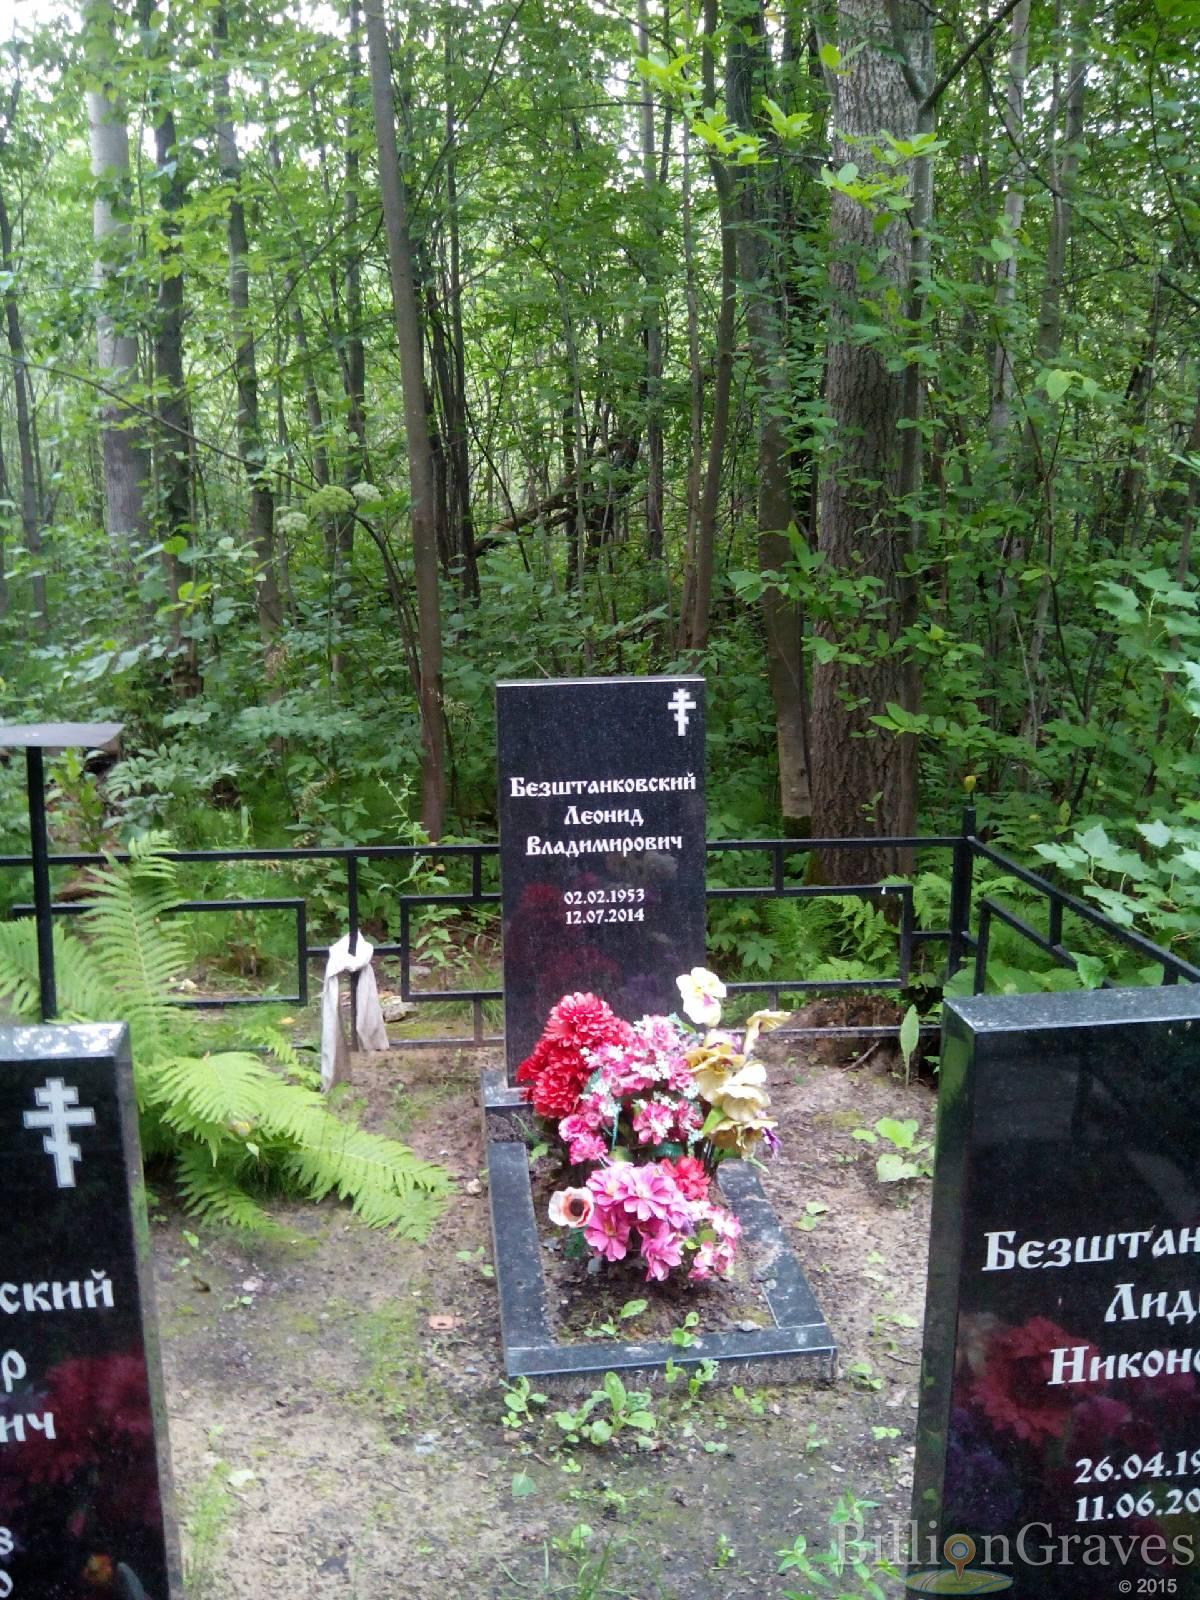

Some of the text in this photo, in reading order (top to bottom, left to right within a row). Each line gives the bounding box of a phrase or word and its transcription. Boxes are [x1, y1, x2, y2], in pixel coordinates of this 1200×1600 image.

[510, 772, 696, 797] Безштанковский
[564, 805, 644, 825] Леонид
[525, 835, 682, 857] Владимирович
[563, 888, 645, 905] 02.02.1953
[565, 907, 645, 924] 12.07.2014
[1104, 1283, 1200, 1325] Лид
